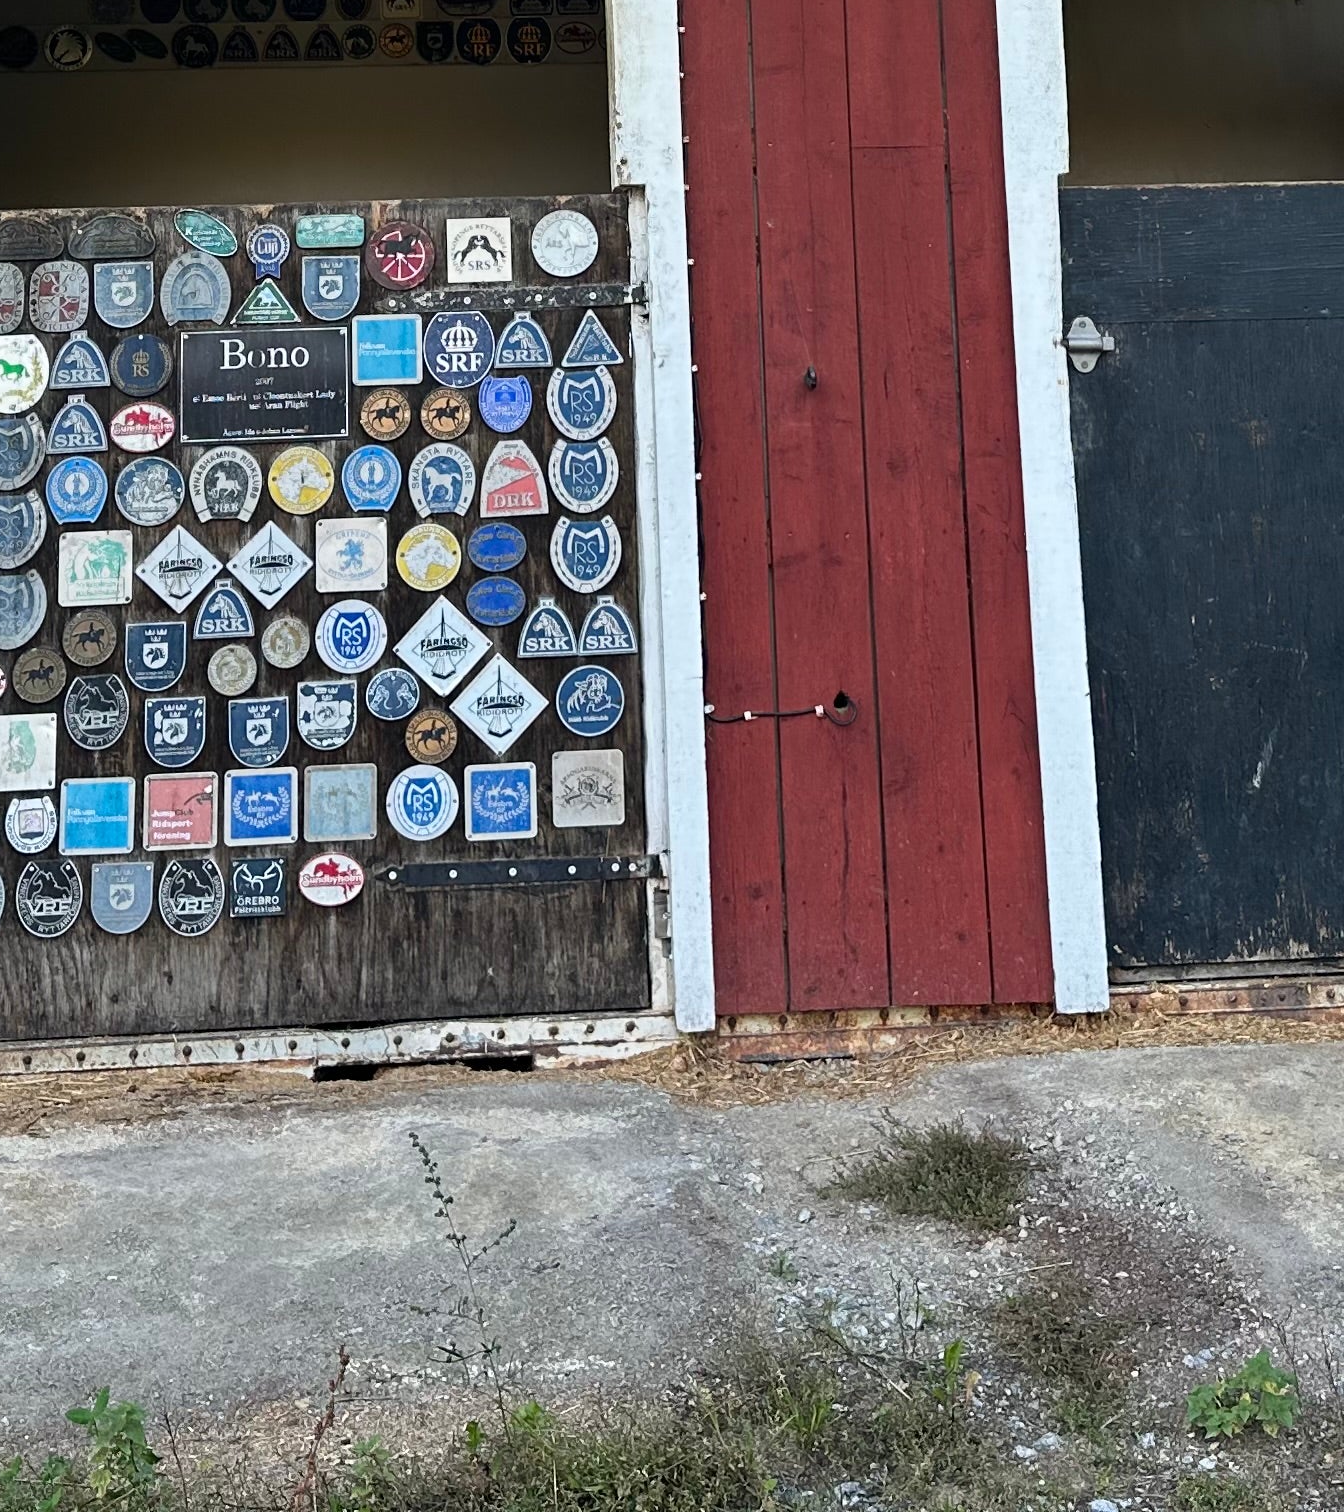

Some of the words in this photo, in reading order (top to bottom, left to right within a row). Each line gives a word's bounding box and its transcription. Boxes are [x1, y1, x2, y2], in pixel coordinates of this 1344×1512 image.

[257, 237, 278, 257] Cup
[468, 260, 491, 270] SRS
[220, 339, 310, 369] Bono
[502, 348, 545, 362] SRK
[436, 352, 484, 373] SRF
[58, 368, 102, 382] SRK
[132, 364, 149, 377] RS
[570, 413, 597, 425] 1949
[54, 432, 100, 448] SRK
[412, 447, 440, 489] SKÄNSTA
[446, 447, 473, 486] RYTTARE
[571, 485, 599, 497] 1949
[573, 564, 600, 577] 1949
[202, 618, 246, 633] SRK
[525, 637, 571, 652] SRK
[586, 635, 630, 649] SRK
[340, 646, 363, 655] 1949
[412, 812, 434, 822] 1949
[301, 873, 361, 888] Sundbyholm
[237, 893, 279, 906] ÖREBRO
